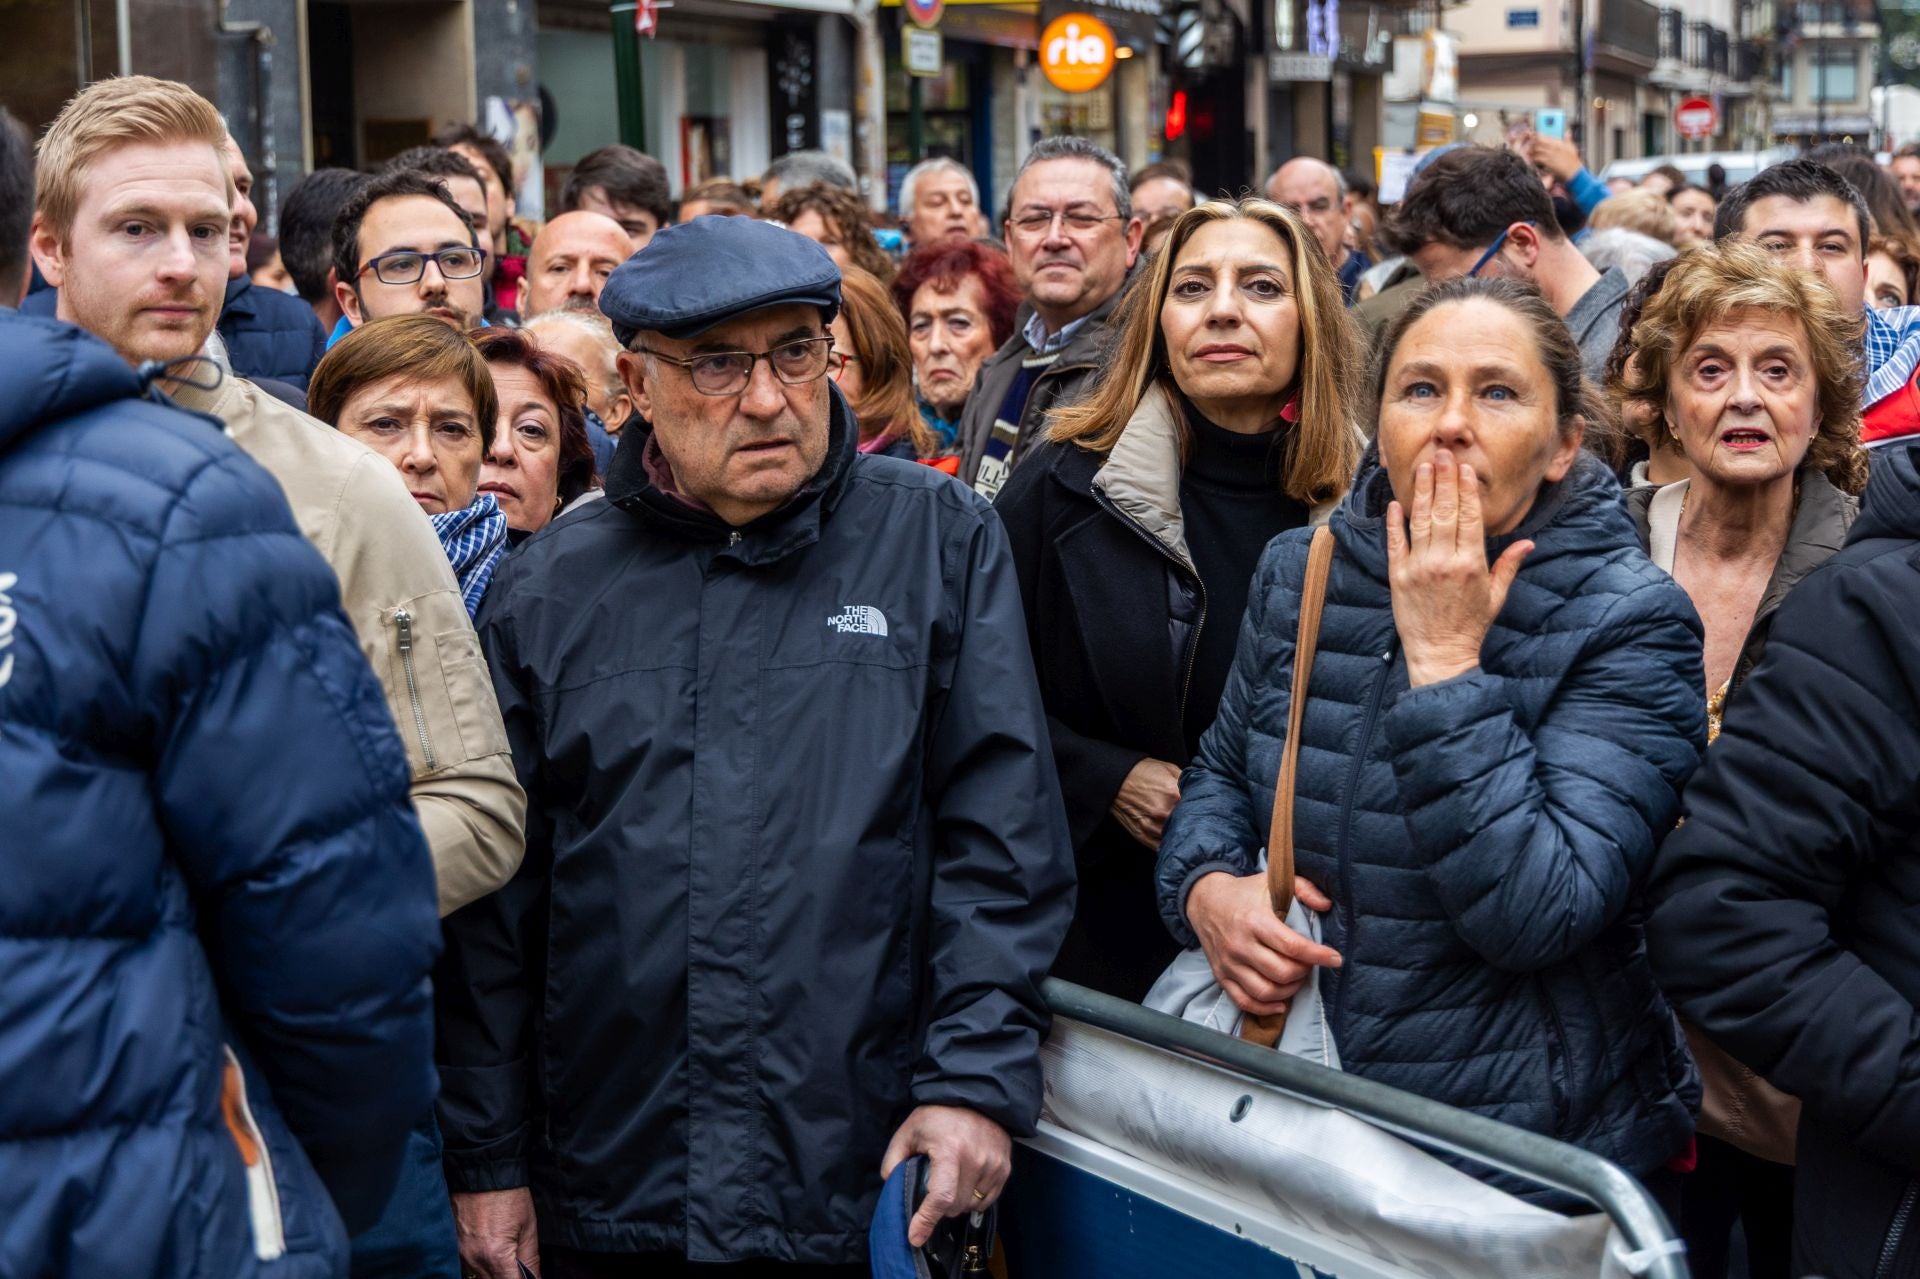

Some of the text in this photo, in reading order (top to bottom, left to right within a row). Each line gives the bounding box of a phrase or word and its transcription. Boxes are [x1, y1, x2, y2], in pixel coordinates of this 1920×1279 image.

[1047, 23, 1106, 66] ria
[843, 605, 869, 615] THE
[827, 614, 867, 626] NORTH
[837, 623, 869, 633] FACE
